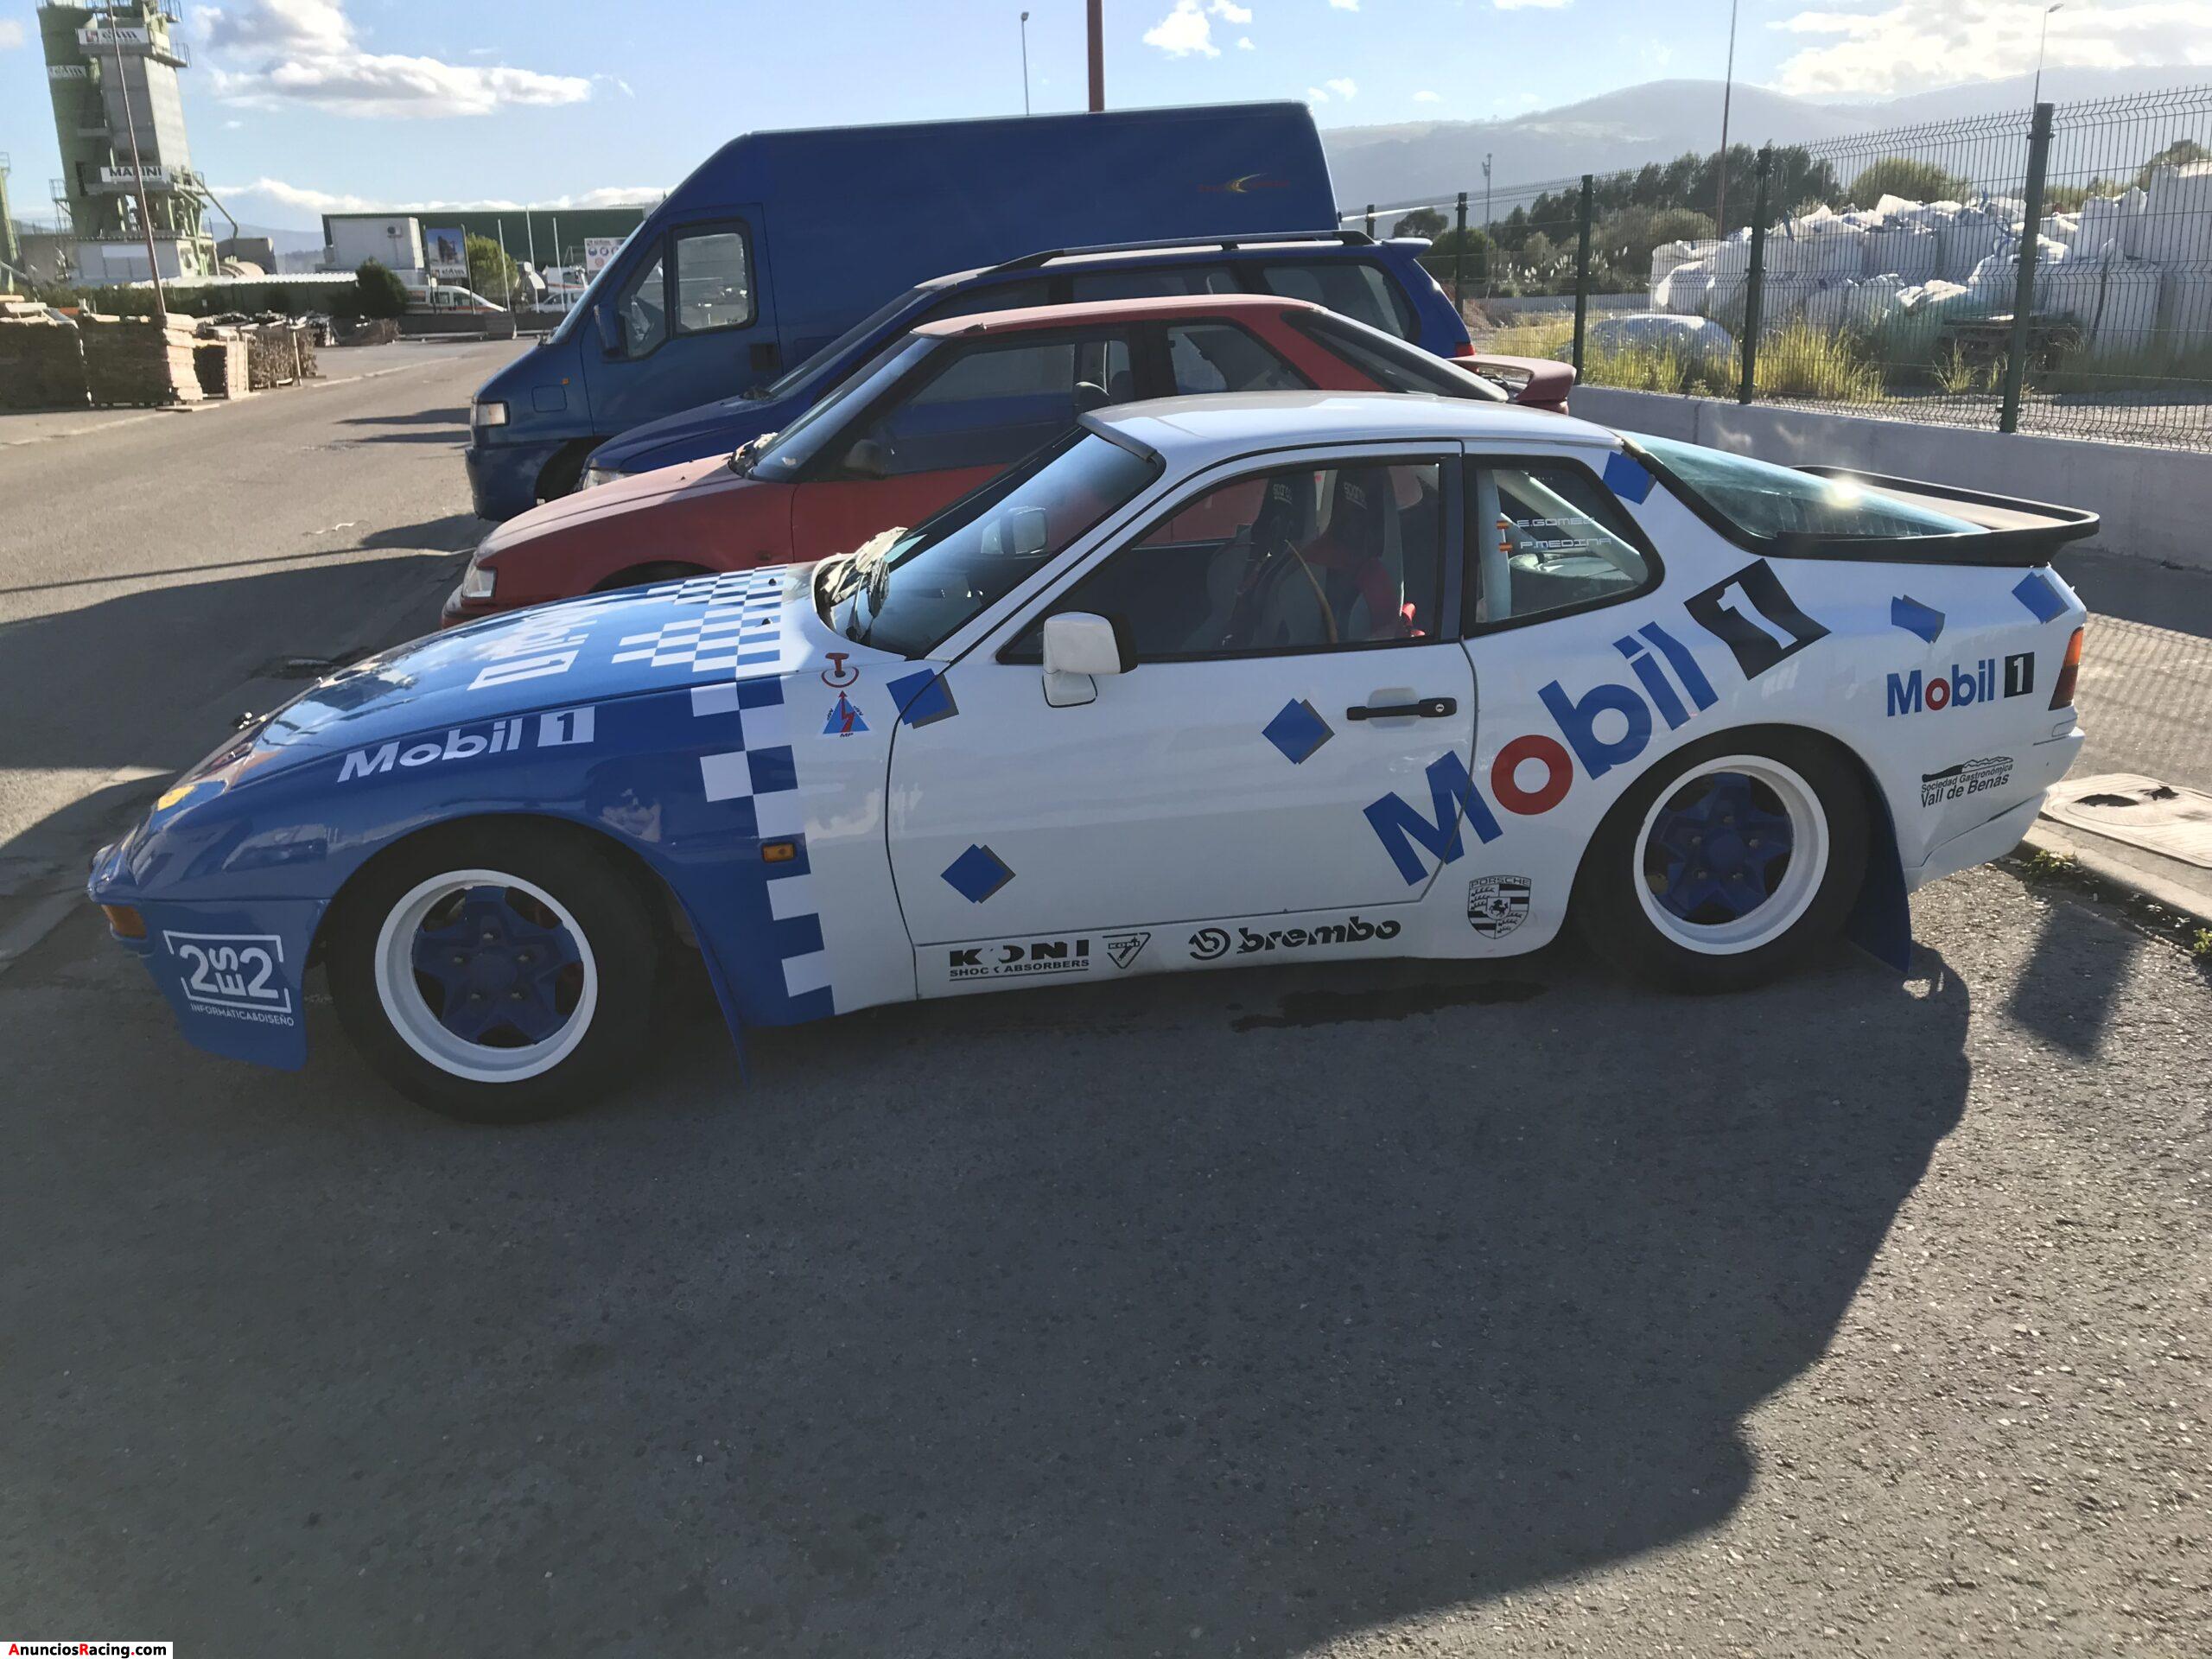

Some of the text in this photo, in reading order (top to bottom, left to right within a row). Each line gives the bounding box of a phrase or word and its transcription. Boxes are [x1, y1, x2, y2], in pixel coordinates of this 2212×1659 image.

[110, 167, 162, 176] MAINI
[1520, 538, 1612, 549] P.MEDINA
[1886, 658, 1995, 717] Mobil
[337, 717, 523, 783] Mobil
[1363, 620, 1719, 886] Mobil
[1922, 776, 1958, 793] Sociedad
[1921, 788, 1943, 808] Vall
[1947, 785, 1964, 800] de
[1471, 876, 1531, 888] PORSCHE
[1236, 916, 1402, 954] brembo
[1003, 959, 1090, 974] ABSORBERS
